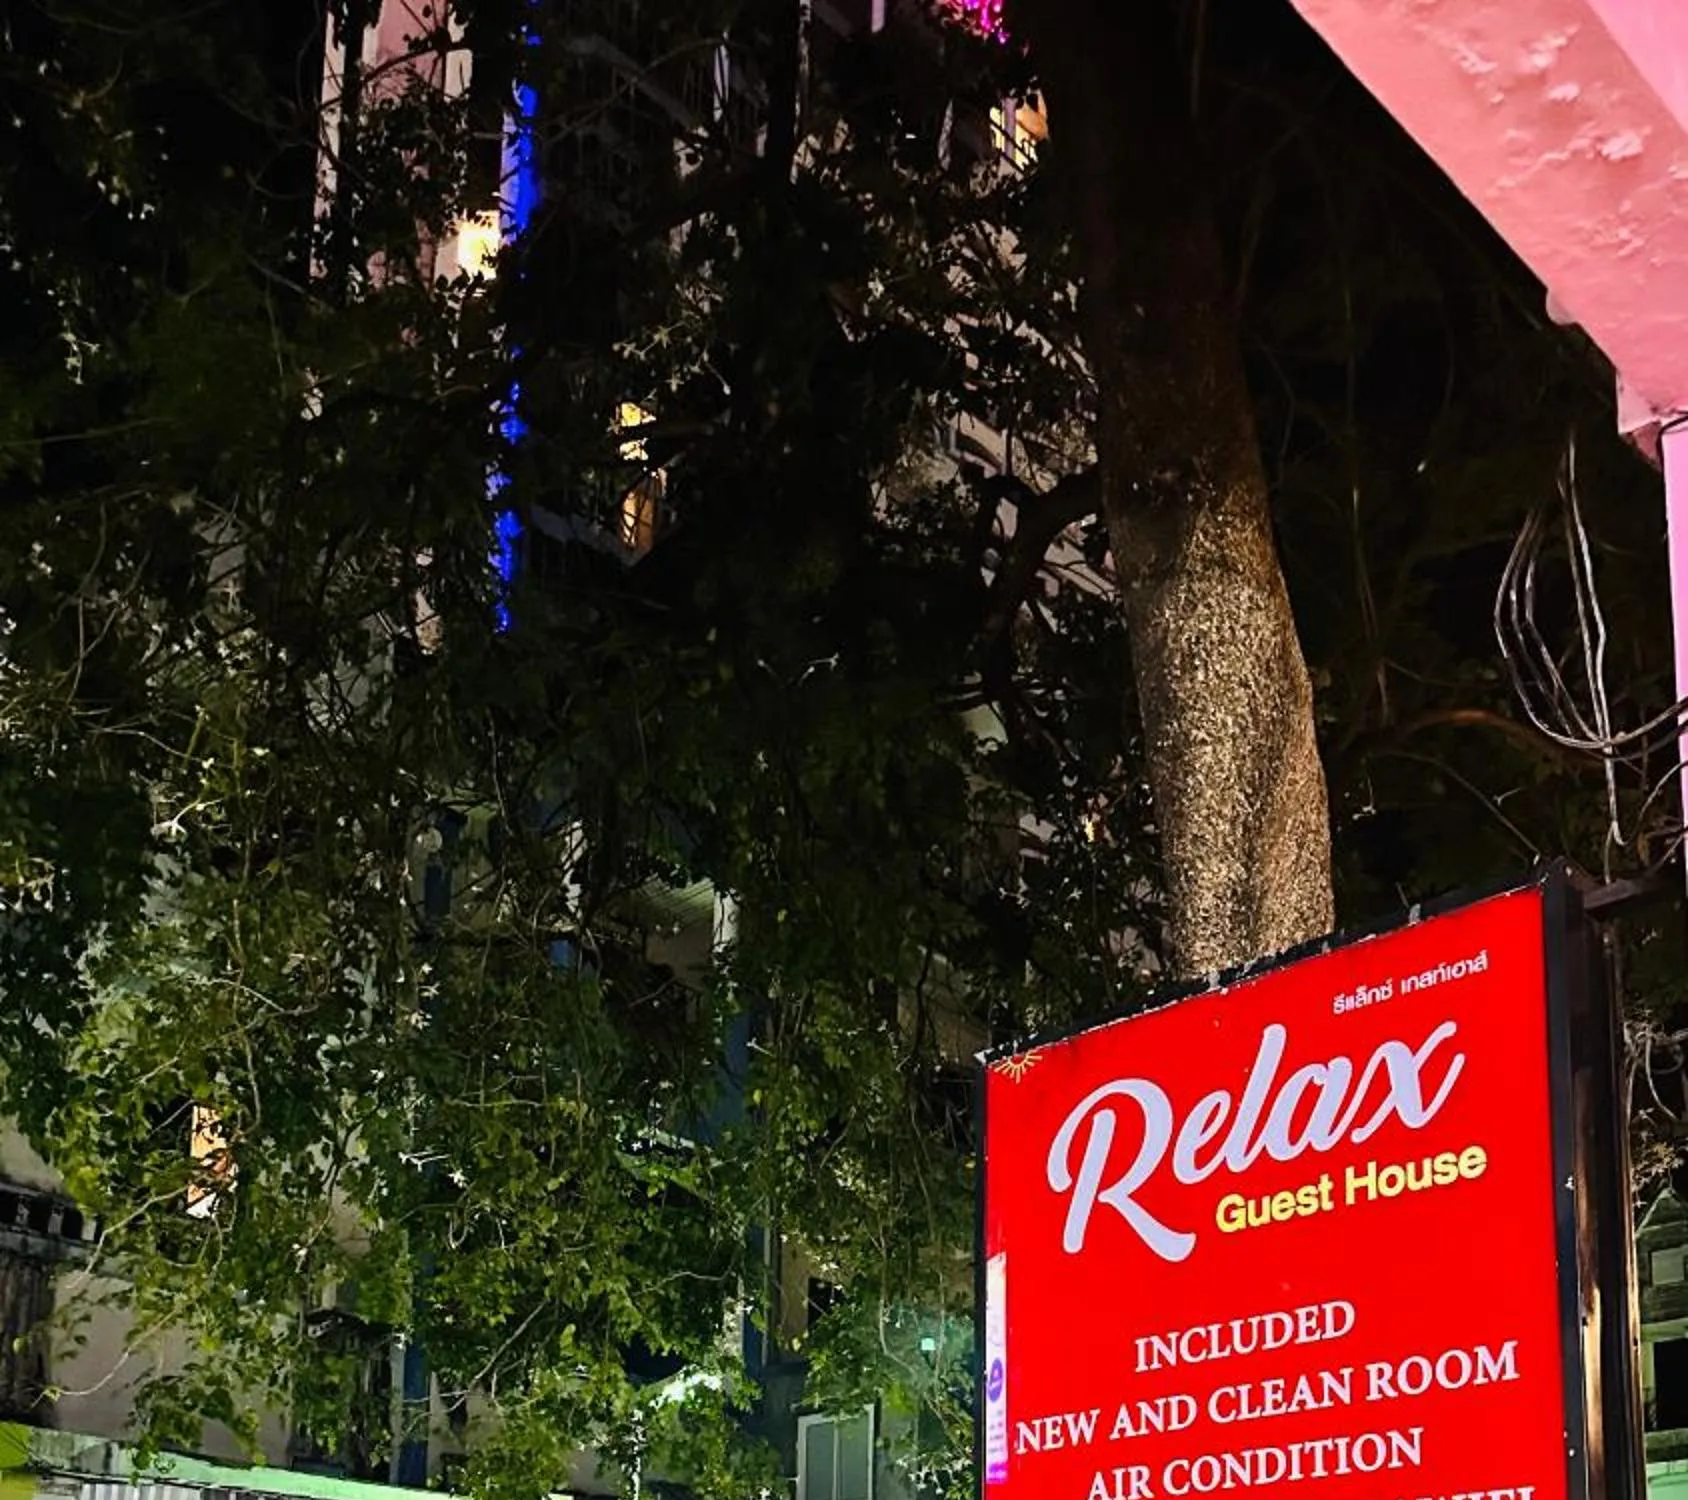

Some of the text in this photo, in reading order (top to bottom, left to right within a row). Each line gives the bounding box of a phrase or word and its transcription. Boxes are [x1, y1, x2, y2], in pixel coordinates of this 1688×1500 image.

[1047, 1022, 1465, 1262] Relax
[1216, 1144, 1487, 1233] Guest House
[1135, 1301, 1355, 1372] INCLUDED
[1015, 1409, 1101, 1455] NEW
[1110, 1395, 1197, 1440] AND
[1208, 1367, 1354, 1424] CLEAN
[1366, 1340, 1520, 1401] ROOM
[1162, 1428, 1424, 1496] CONDITION
